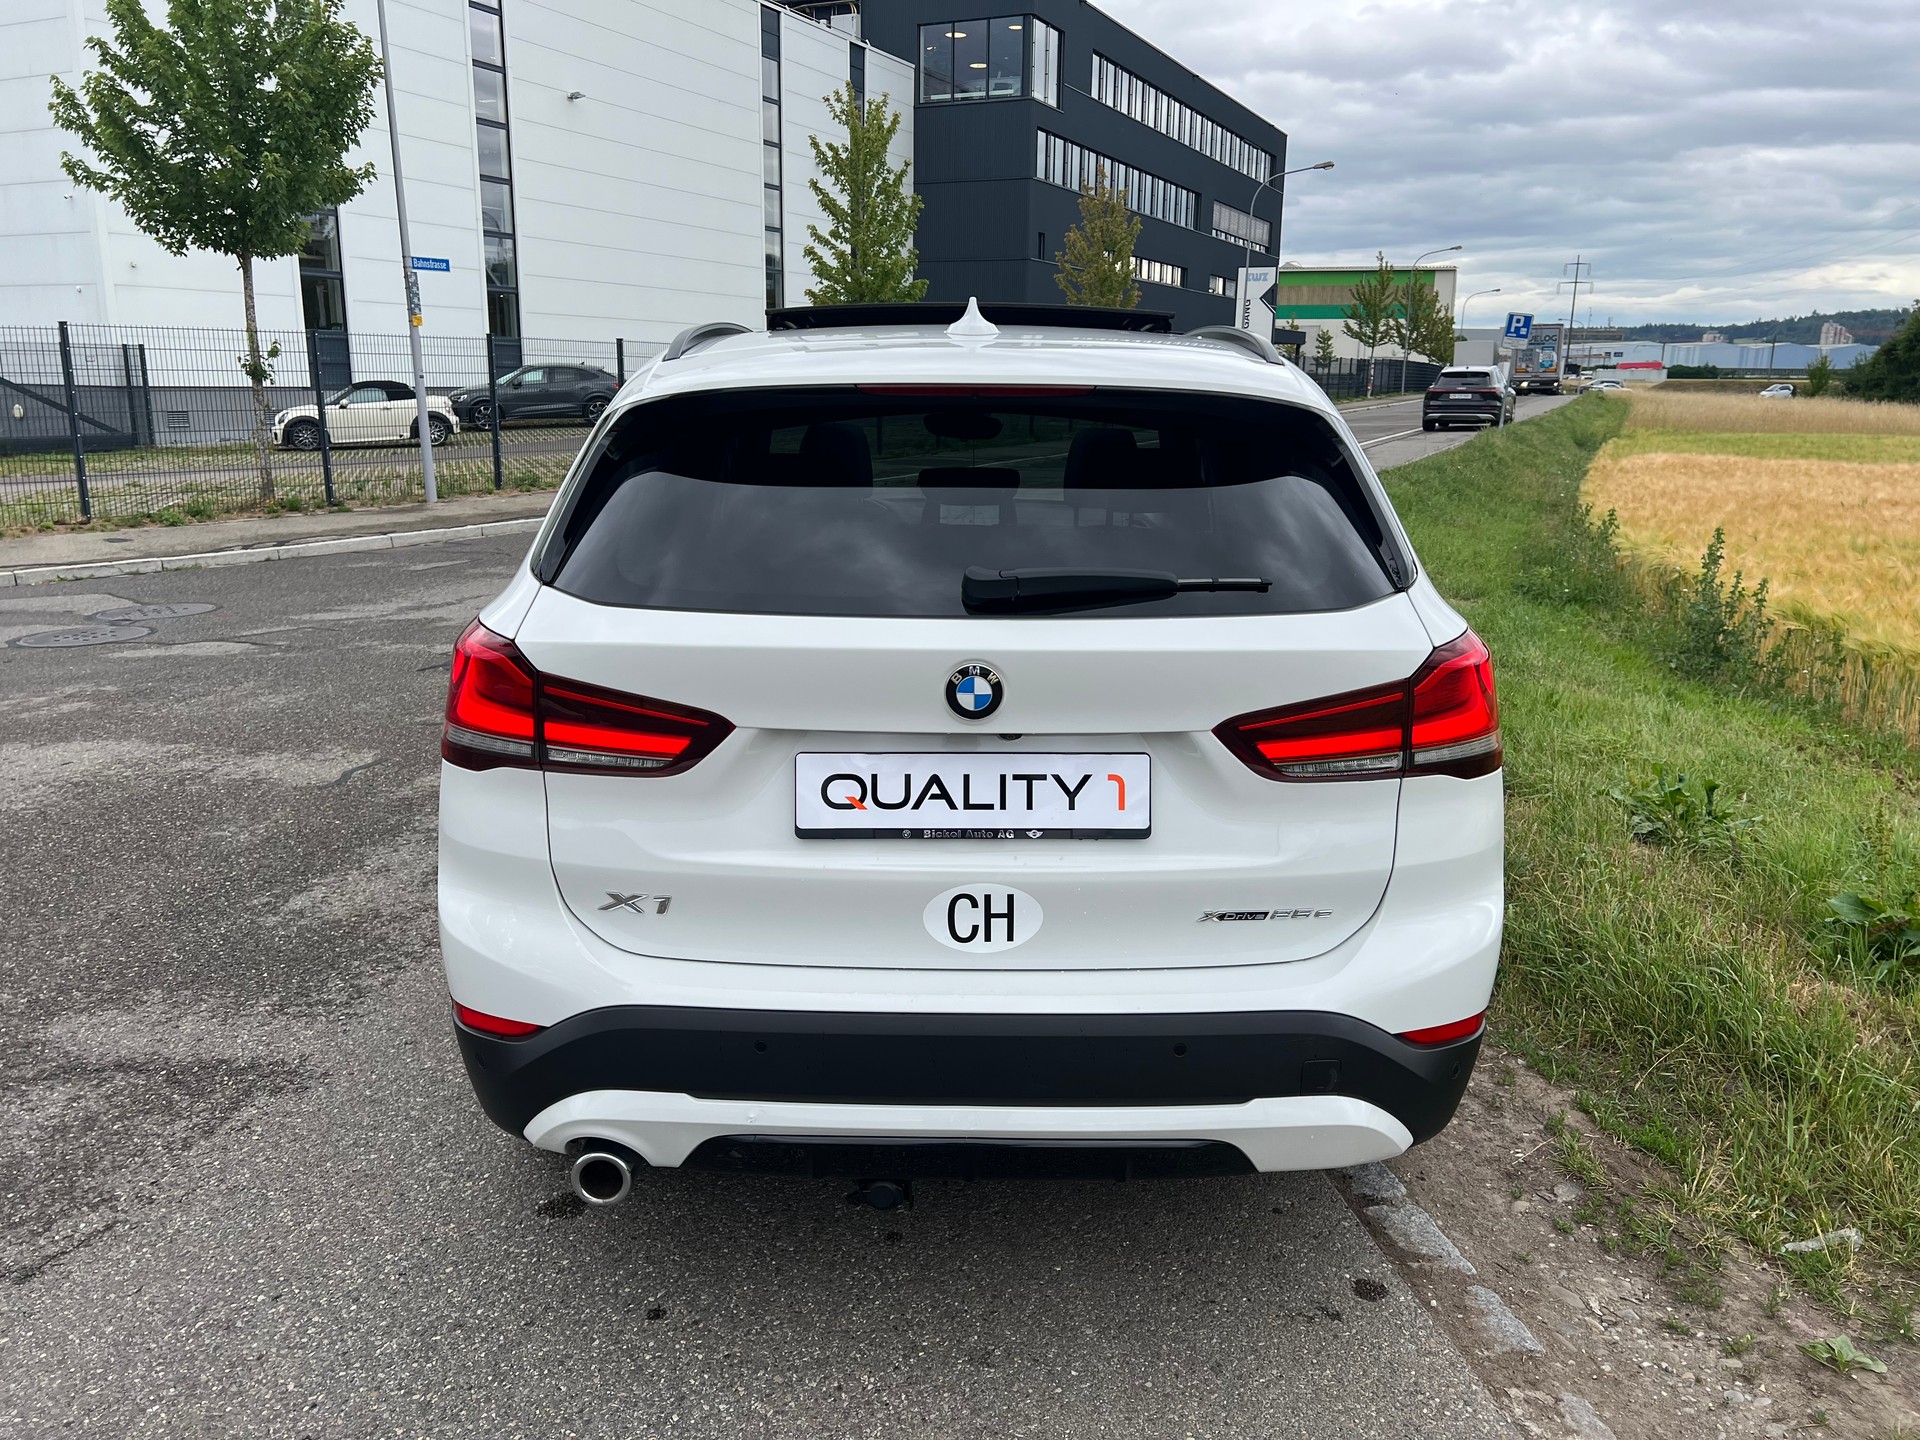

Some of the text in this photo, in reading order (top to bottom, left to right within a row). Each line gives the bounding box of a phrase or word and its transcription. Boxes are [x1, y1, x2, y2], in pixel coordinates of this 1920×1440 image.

[413, 258, 446, 269] Bahnstrasse
[1510, 315, 1525, 333] P
[951, 665, 999, 685] BMW
[820, 773, 1126, 811] QUALITY 1
[965, 829, 994, 839] Auto
[997, 829, 1015, 839] AG
[597, 890, 672, 915] X1
[947, 893, 1015, 944] CH
